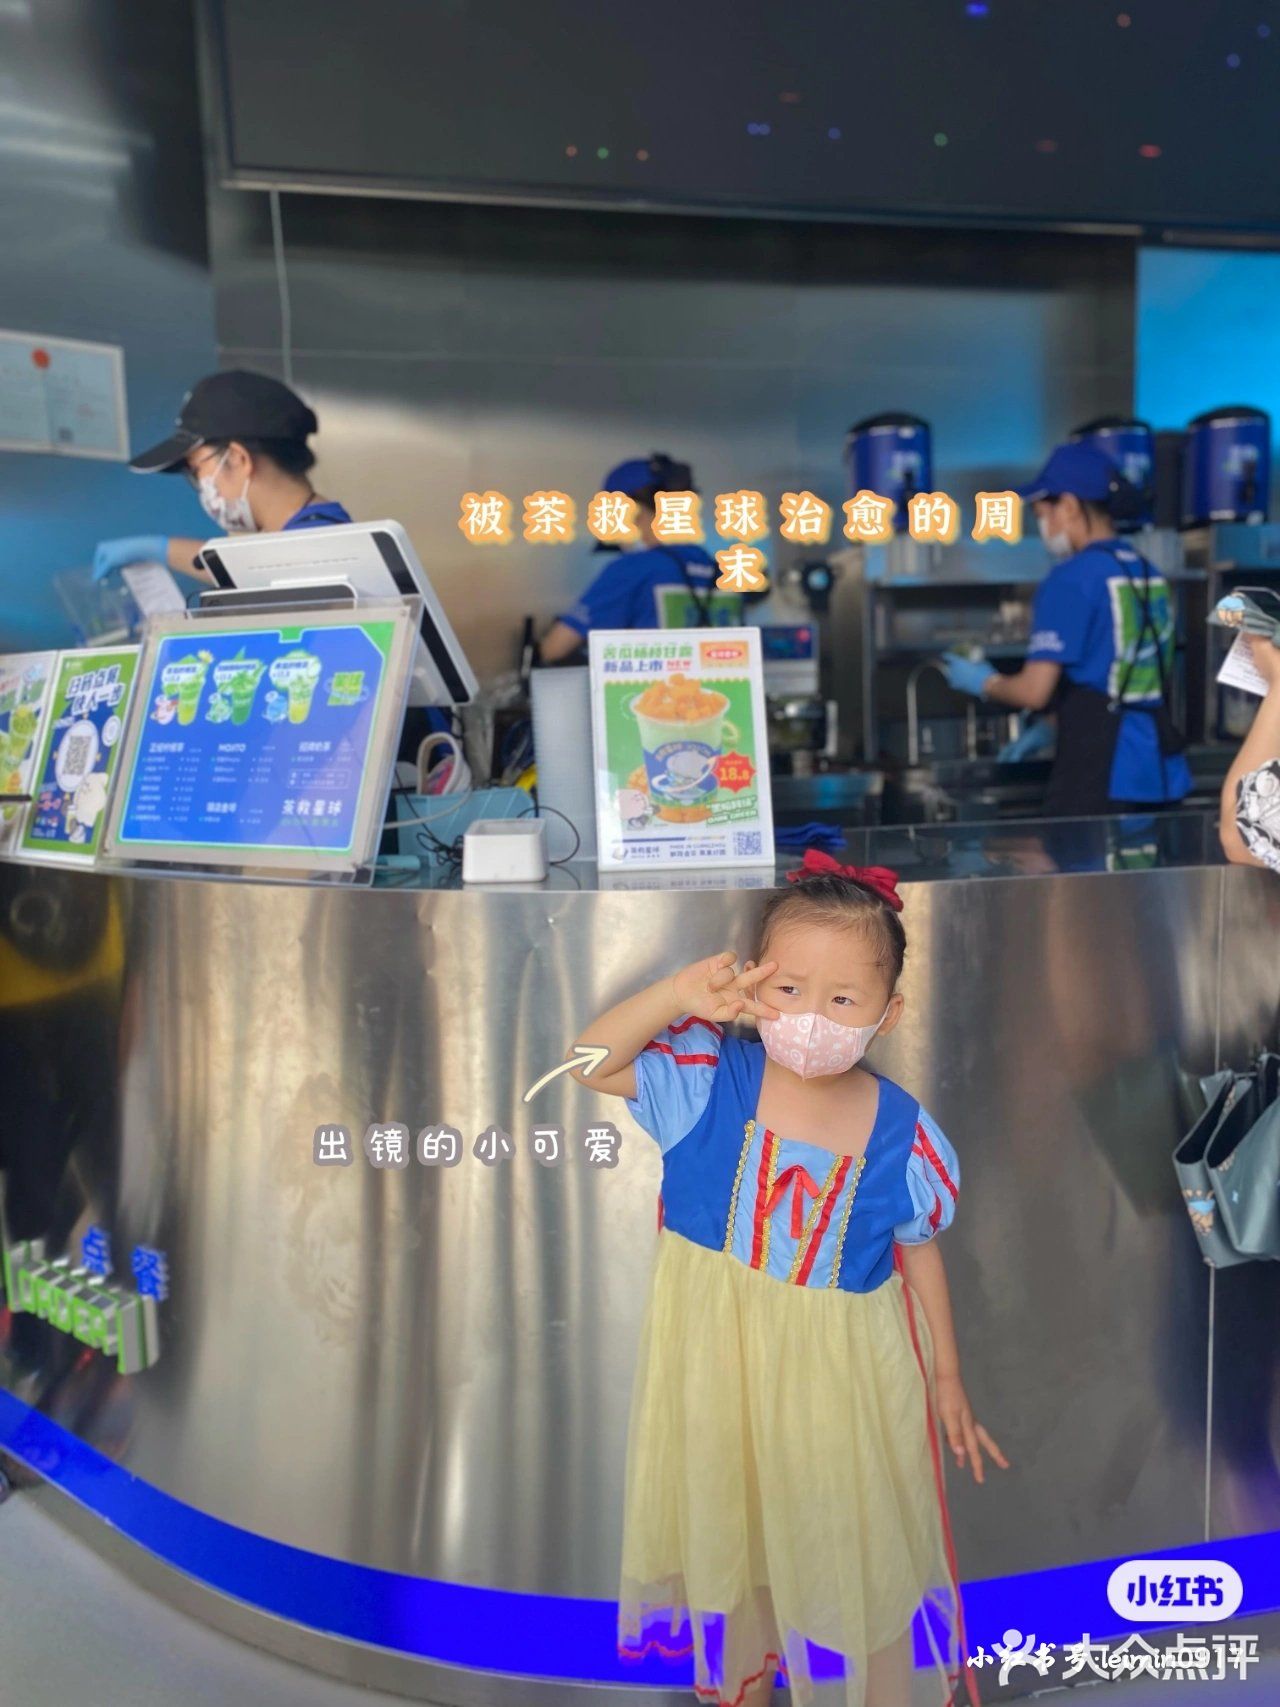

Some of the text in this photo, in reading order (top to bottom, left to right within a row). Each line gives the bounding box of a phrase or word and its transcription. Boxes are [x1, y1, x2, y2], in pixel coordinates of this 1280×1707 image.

[603, 659, 664, 673] 新品上市
[281, 798, 342, 817] 茶救星球
